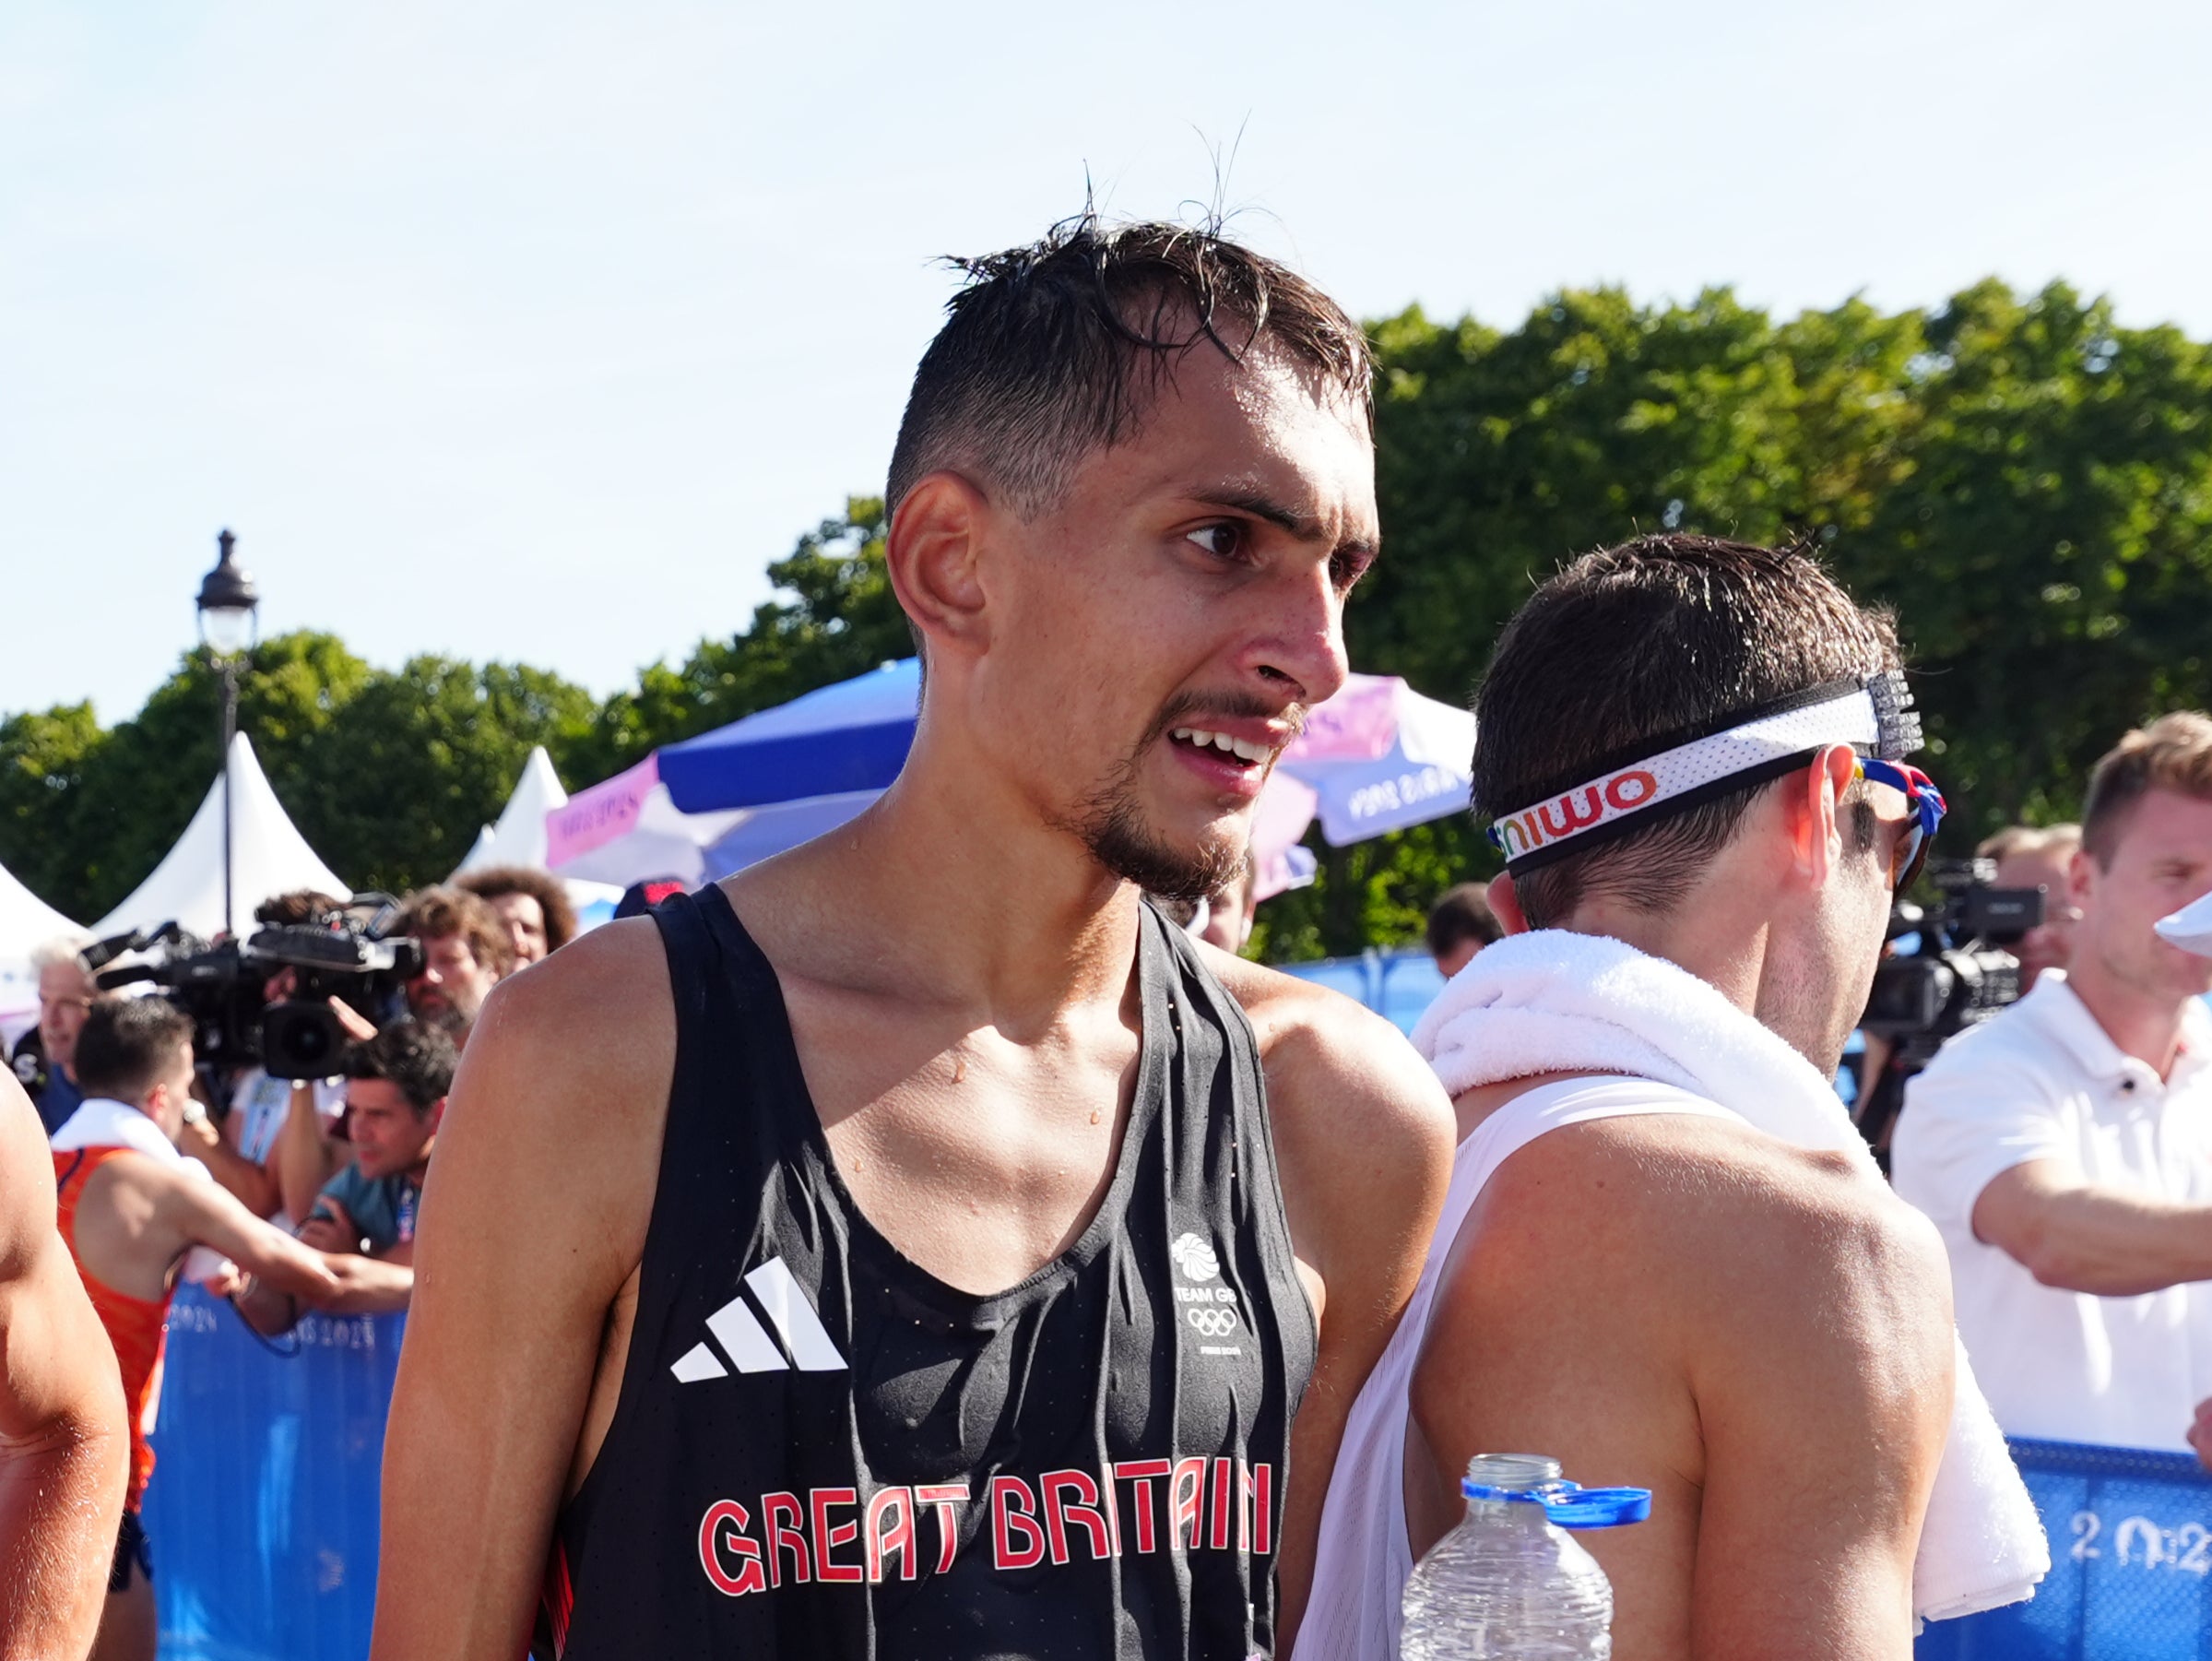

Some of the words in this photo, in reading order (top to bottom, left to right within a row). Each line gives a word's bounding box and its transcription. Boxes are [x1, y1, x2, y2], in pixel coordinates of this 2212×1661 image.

[1174, 1287, 1213, 1302] TEAM
[1215, 1287, 1237, 1302] GB
[698, 1483, 970, 1596] GREAT
[993, 1456, 1272, 1570] BRITAIN
